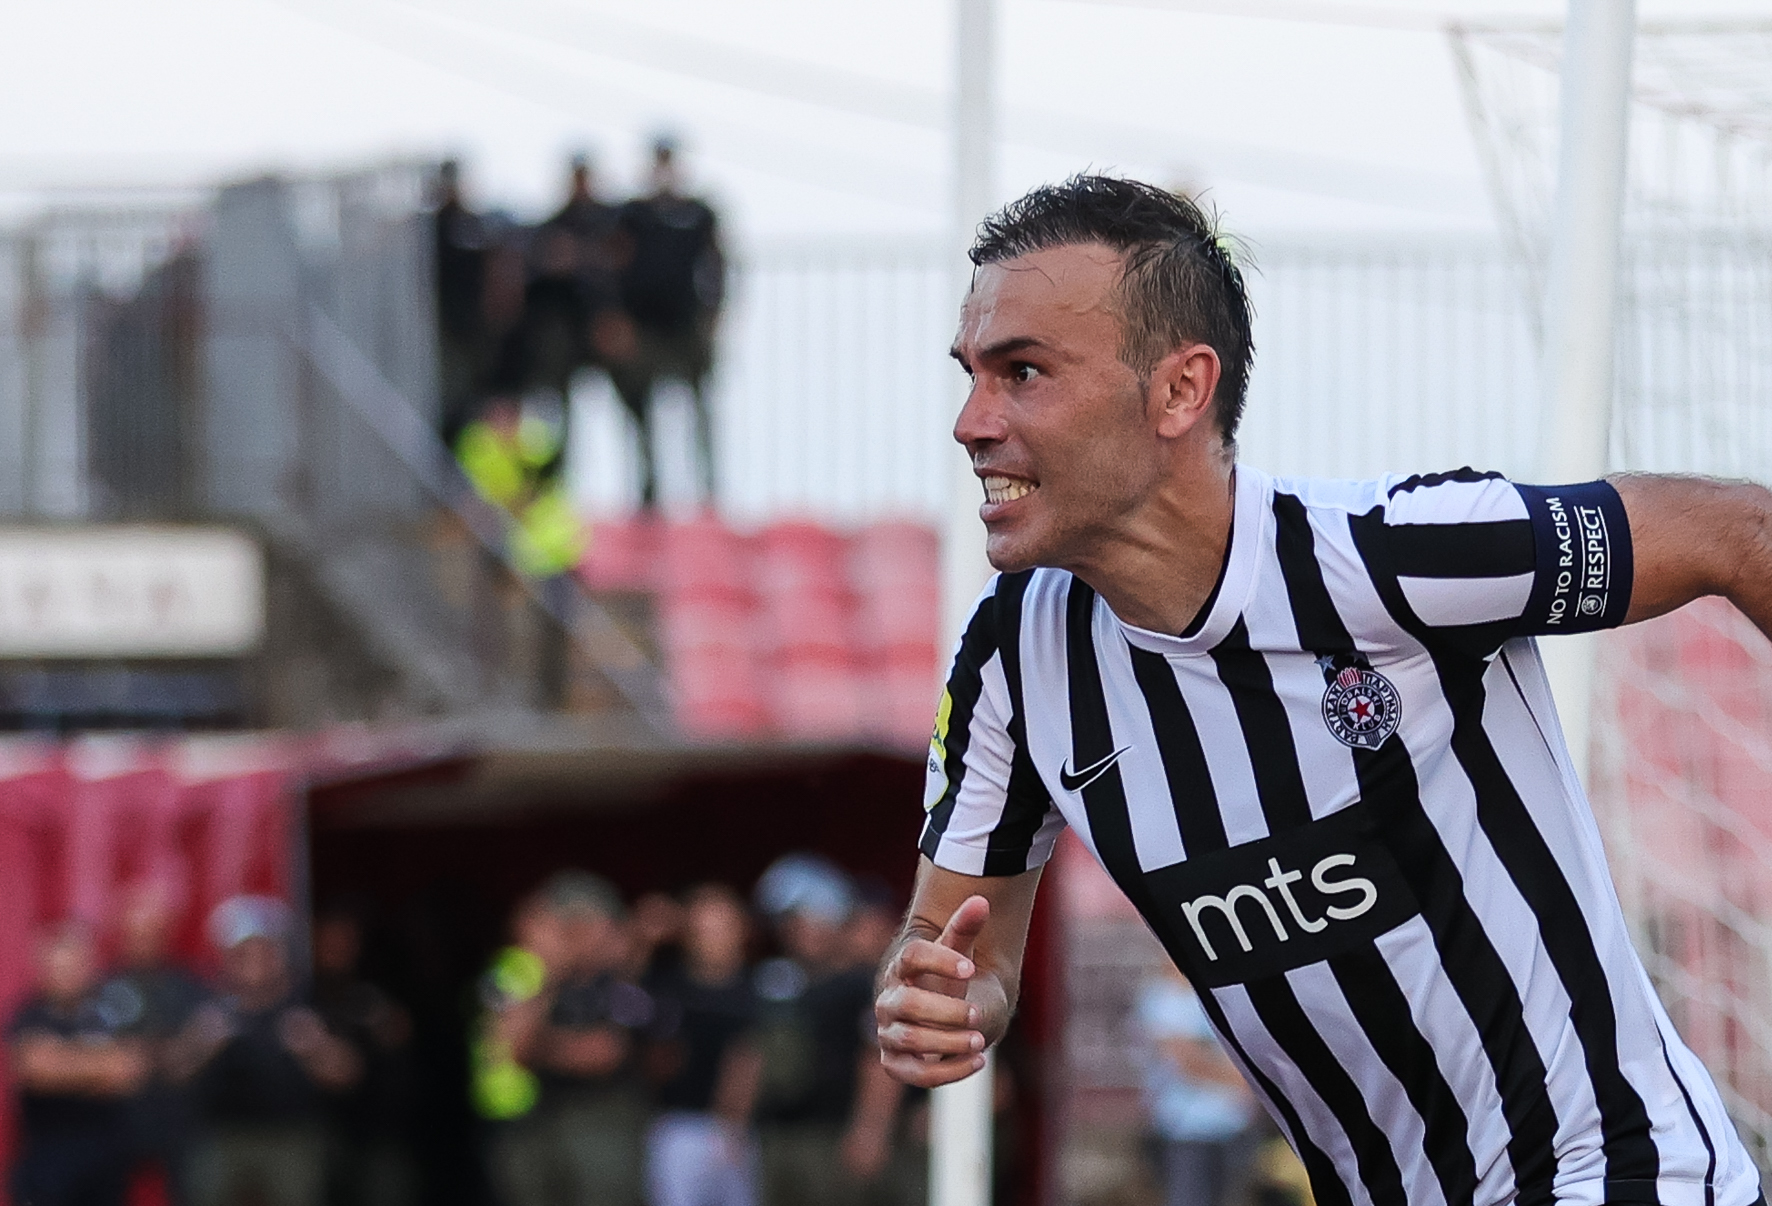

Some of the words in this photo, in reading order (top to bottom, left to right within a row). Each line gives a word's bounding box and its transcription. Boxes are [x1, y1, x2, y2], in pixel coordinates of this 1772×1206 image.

[1545, 497, 1573, 567] RACISM
[1580, 505, 1605, 589] RESPECT
[1546, 598, 1567, 625] NO
[1554, 571, 1572, 597] TO
[1180, 853, 1378, 962] mts
